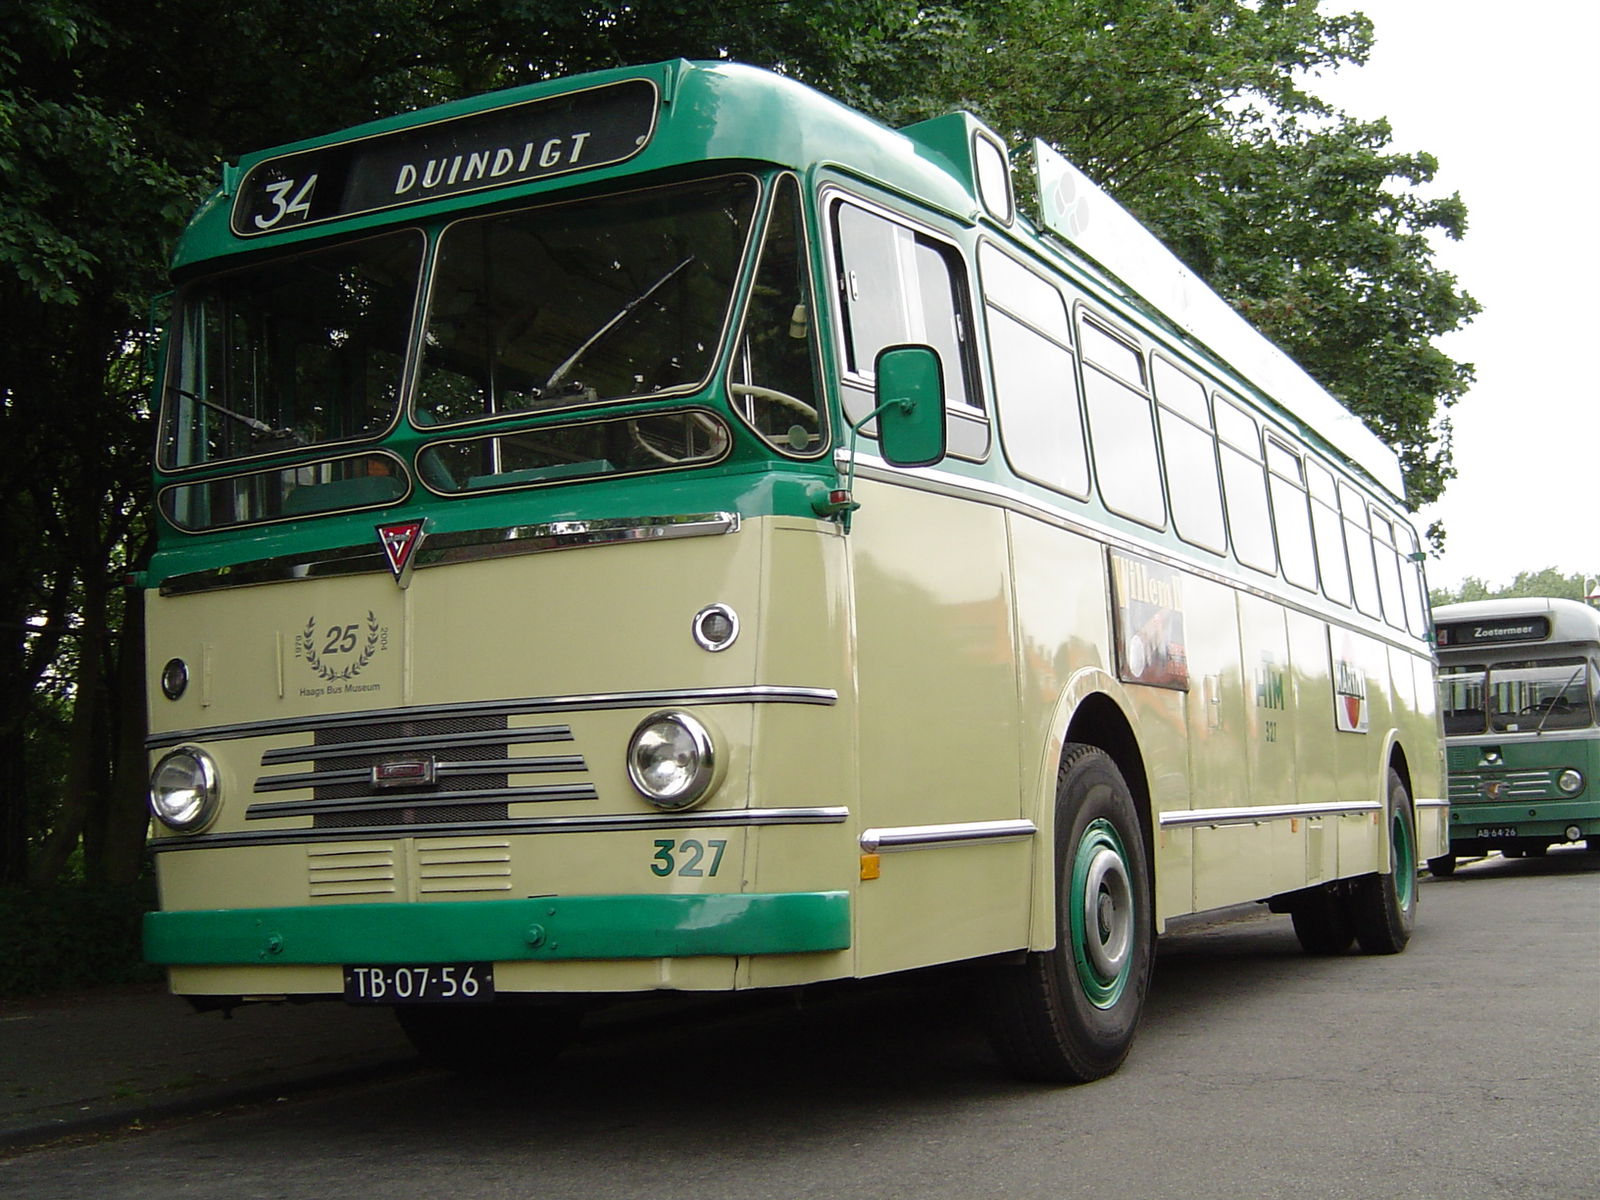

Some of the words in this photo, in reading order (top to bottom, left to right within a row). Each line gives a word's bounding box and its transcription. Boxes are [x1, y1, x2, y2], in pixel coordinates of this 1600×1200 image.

[394, 131, 592, 195] DUINDIGT
[254, 173, 319, 231] 34
[322, 624, 360, 655] 25
[1474, 624, 1534, 638] Zoetermeer
[299, 687, 325, 697] Haags
[326, 685, 343, 695] Bus
[344, 683, 381, 693] Museum
[650, 839, 728, 877] 327
[353, 967, 480, 998] TB-07-56
